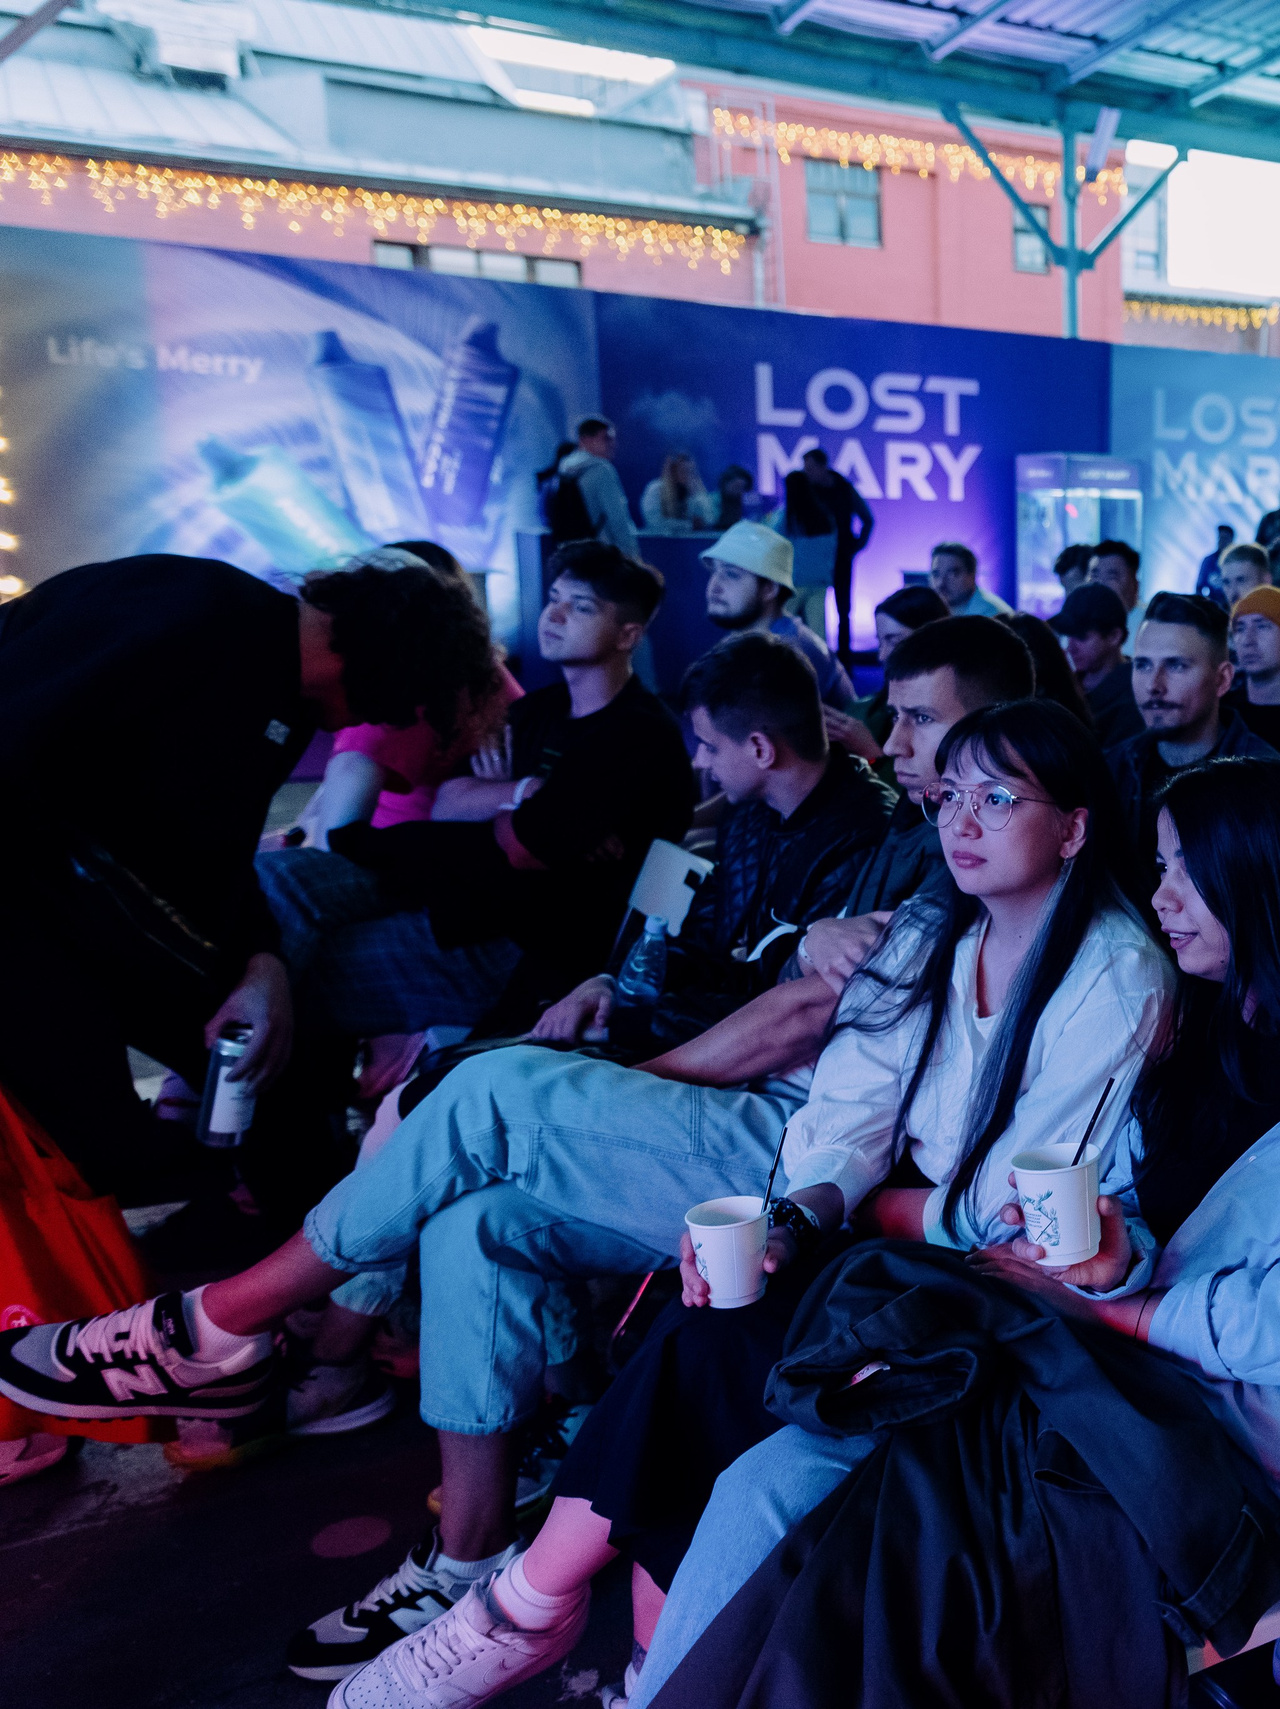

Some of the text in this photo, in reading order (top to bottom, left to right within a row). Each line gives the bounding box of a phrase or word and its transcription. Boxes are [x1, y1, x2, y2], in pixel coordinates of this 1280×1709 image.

[156, 344, 264, 383] Merry
[755, 361, 981, 437] LOST
[757, 432, 983, 502] MARY
[101, 1363, 169, 1402] N
